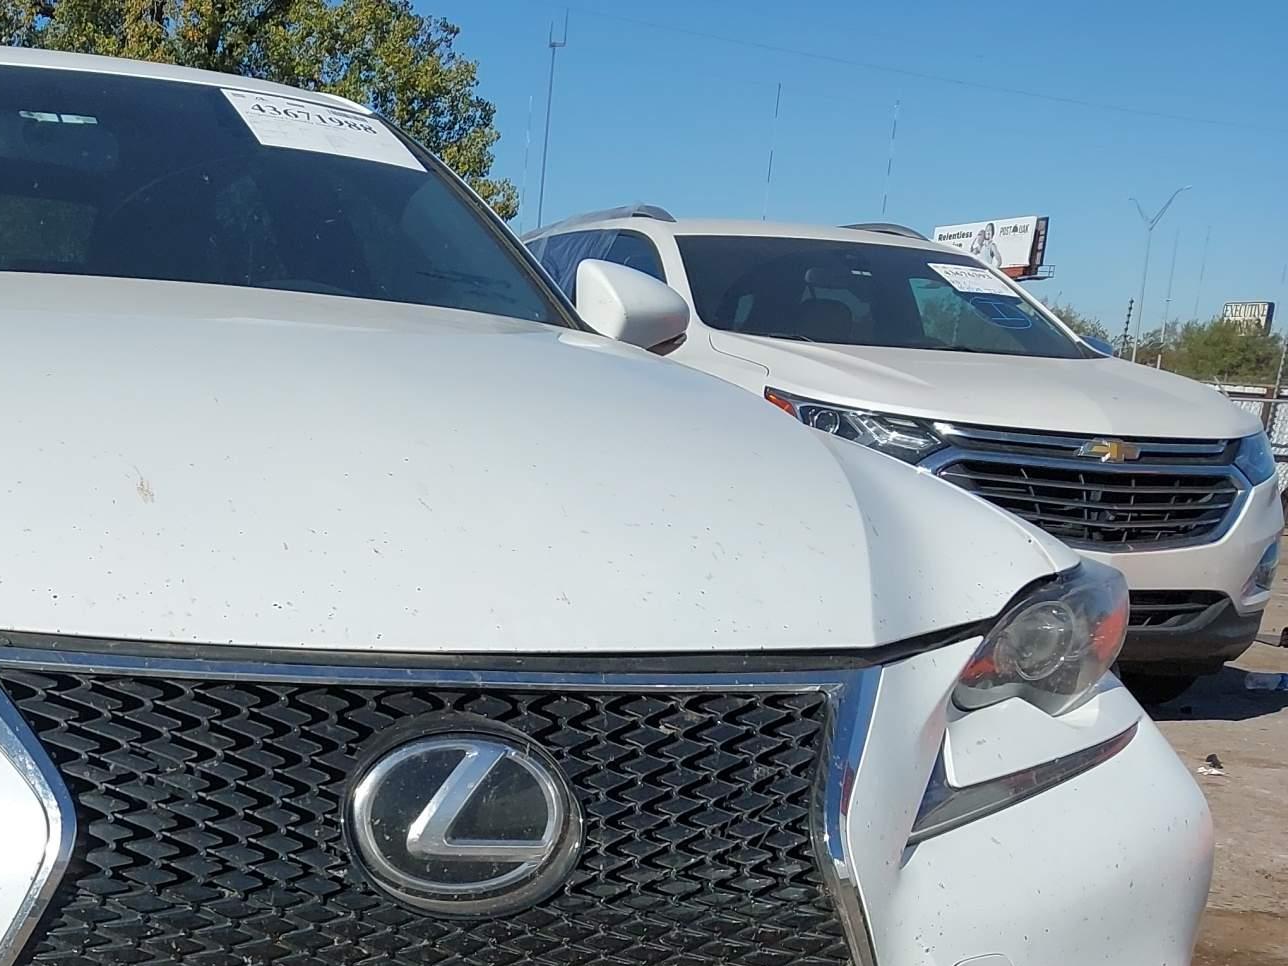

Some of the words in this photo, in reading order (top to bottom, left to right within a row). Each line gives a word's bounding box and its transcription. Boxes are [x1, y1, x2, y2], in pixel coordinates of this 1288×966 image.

[250, 103, 377, 134] 43671988
[938, 231, 973, 242] Relentless
[1223, 304, 1267, 317] EXECUTIVE
